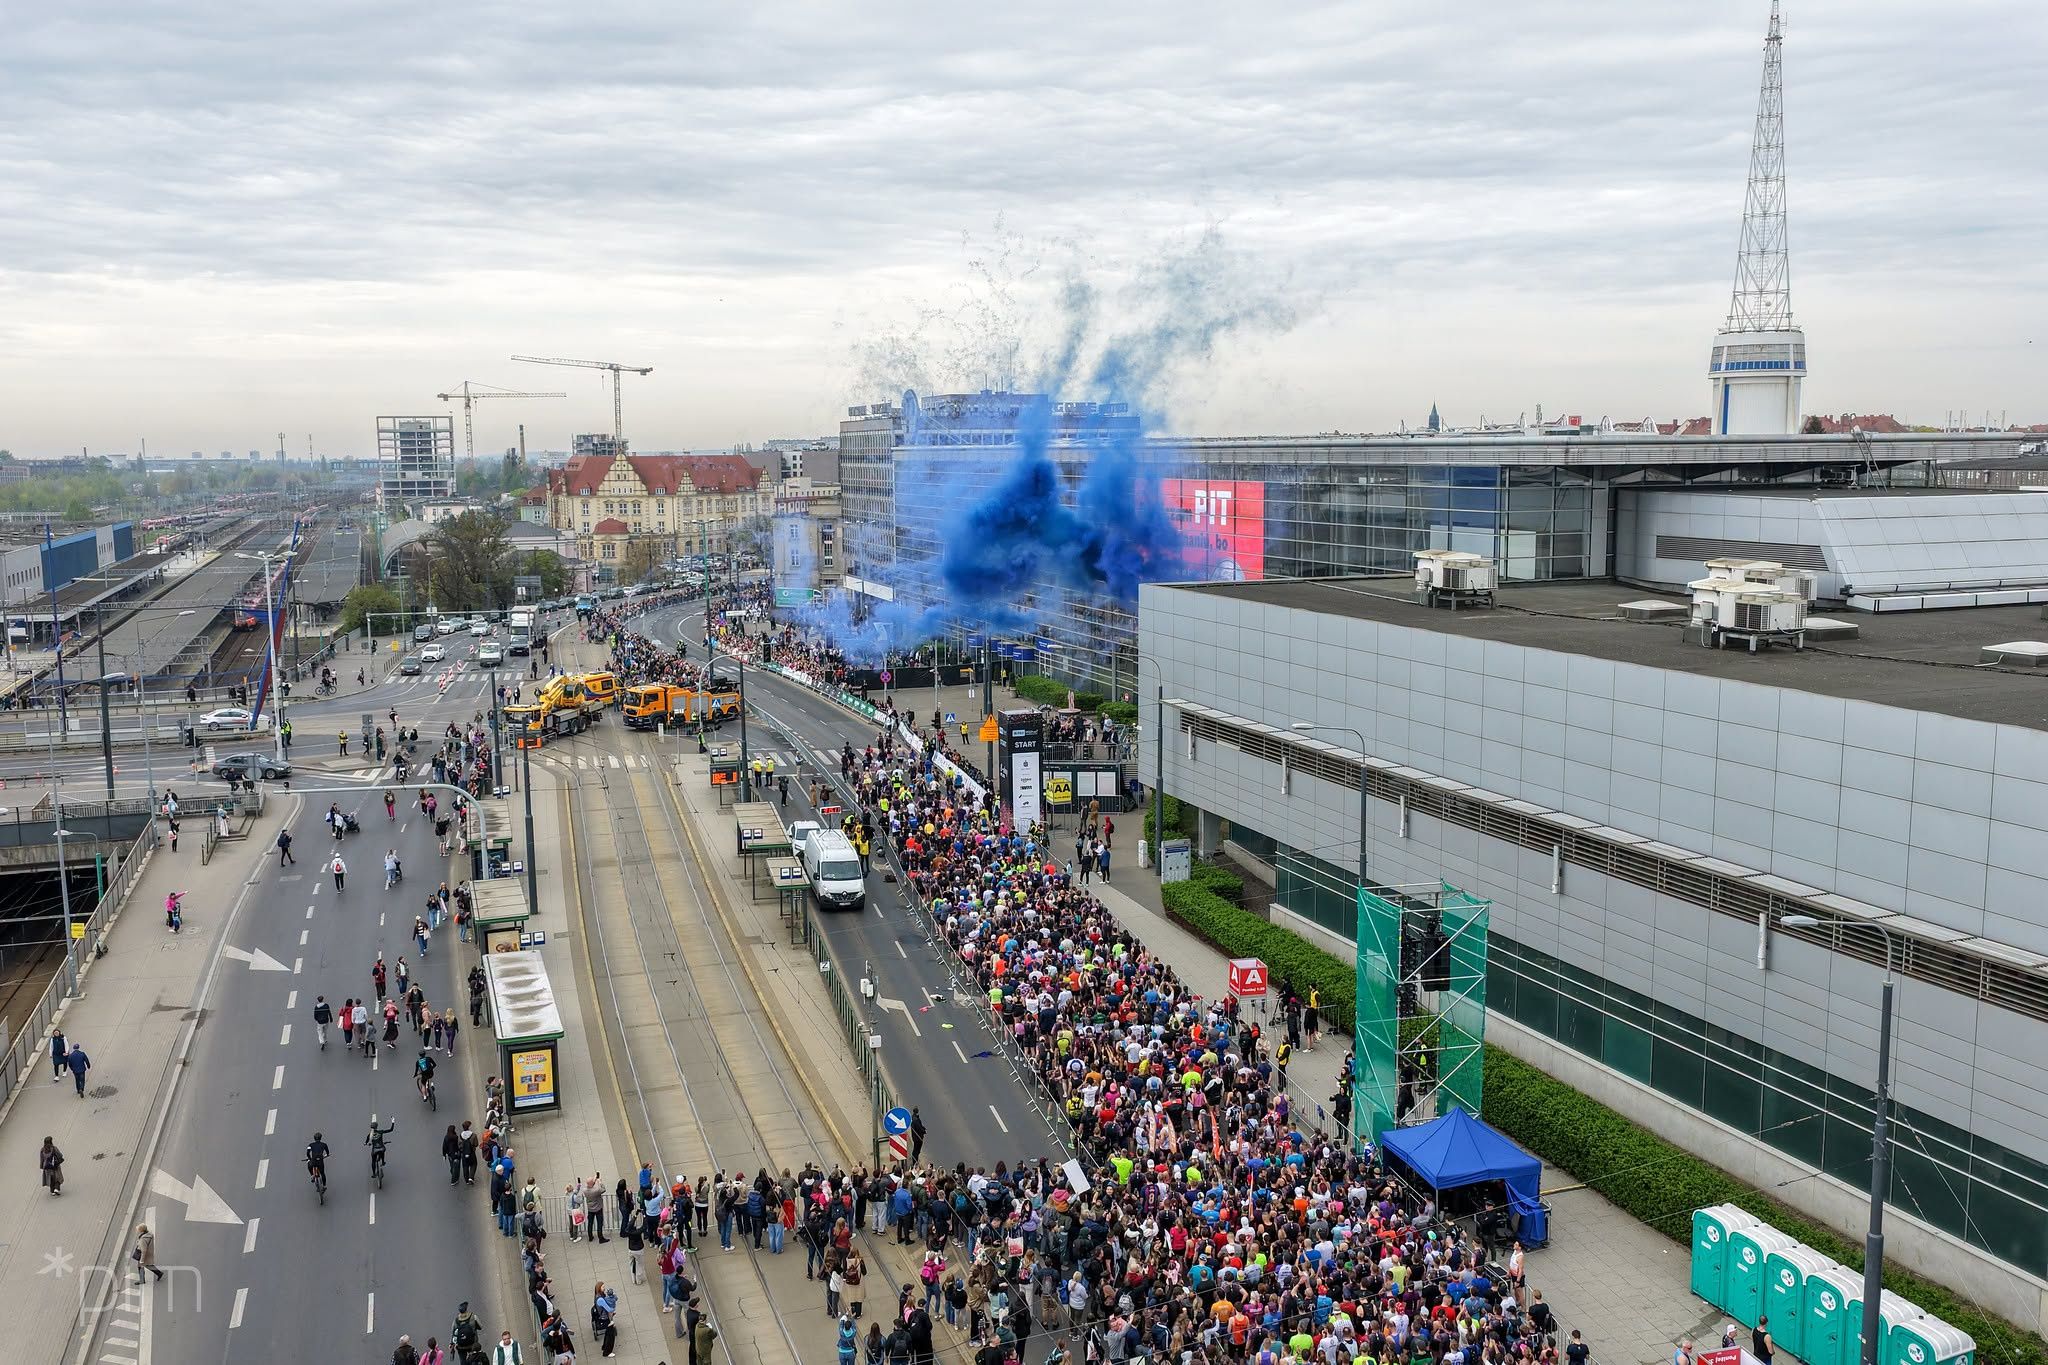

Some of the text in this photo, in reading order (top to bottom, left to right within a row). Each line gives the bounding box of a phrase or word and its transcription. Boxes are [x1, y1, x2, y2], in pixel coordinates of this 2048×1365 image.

[1194, 489, 1232, 526] PIT
[1014, 740, 1037, 749] START
[1054, 783, 1071, 793] AA
[1231, 966, 1239, 984] A
[1245, 969, 1263, 985] A
